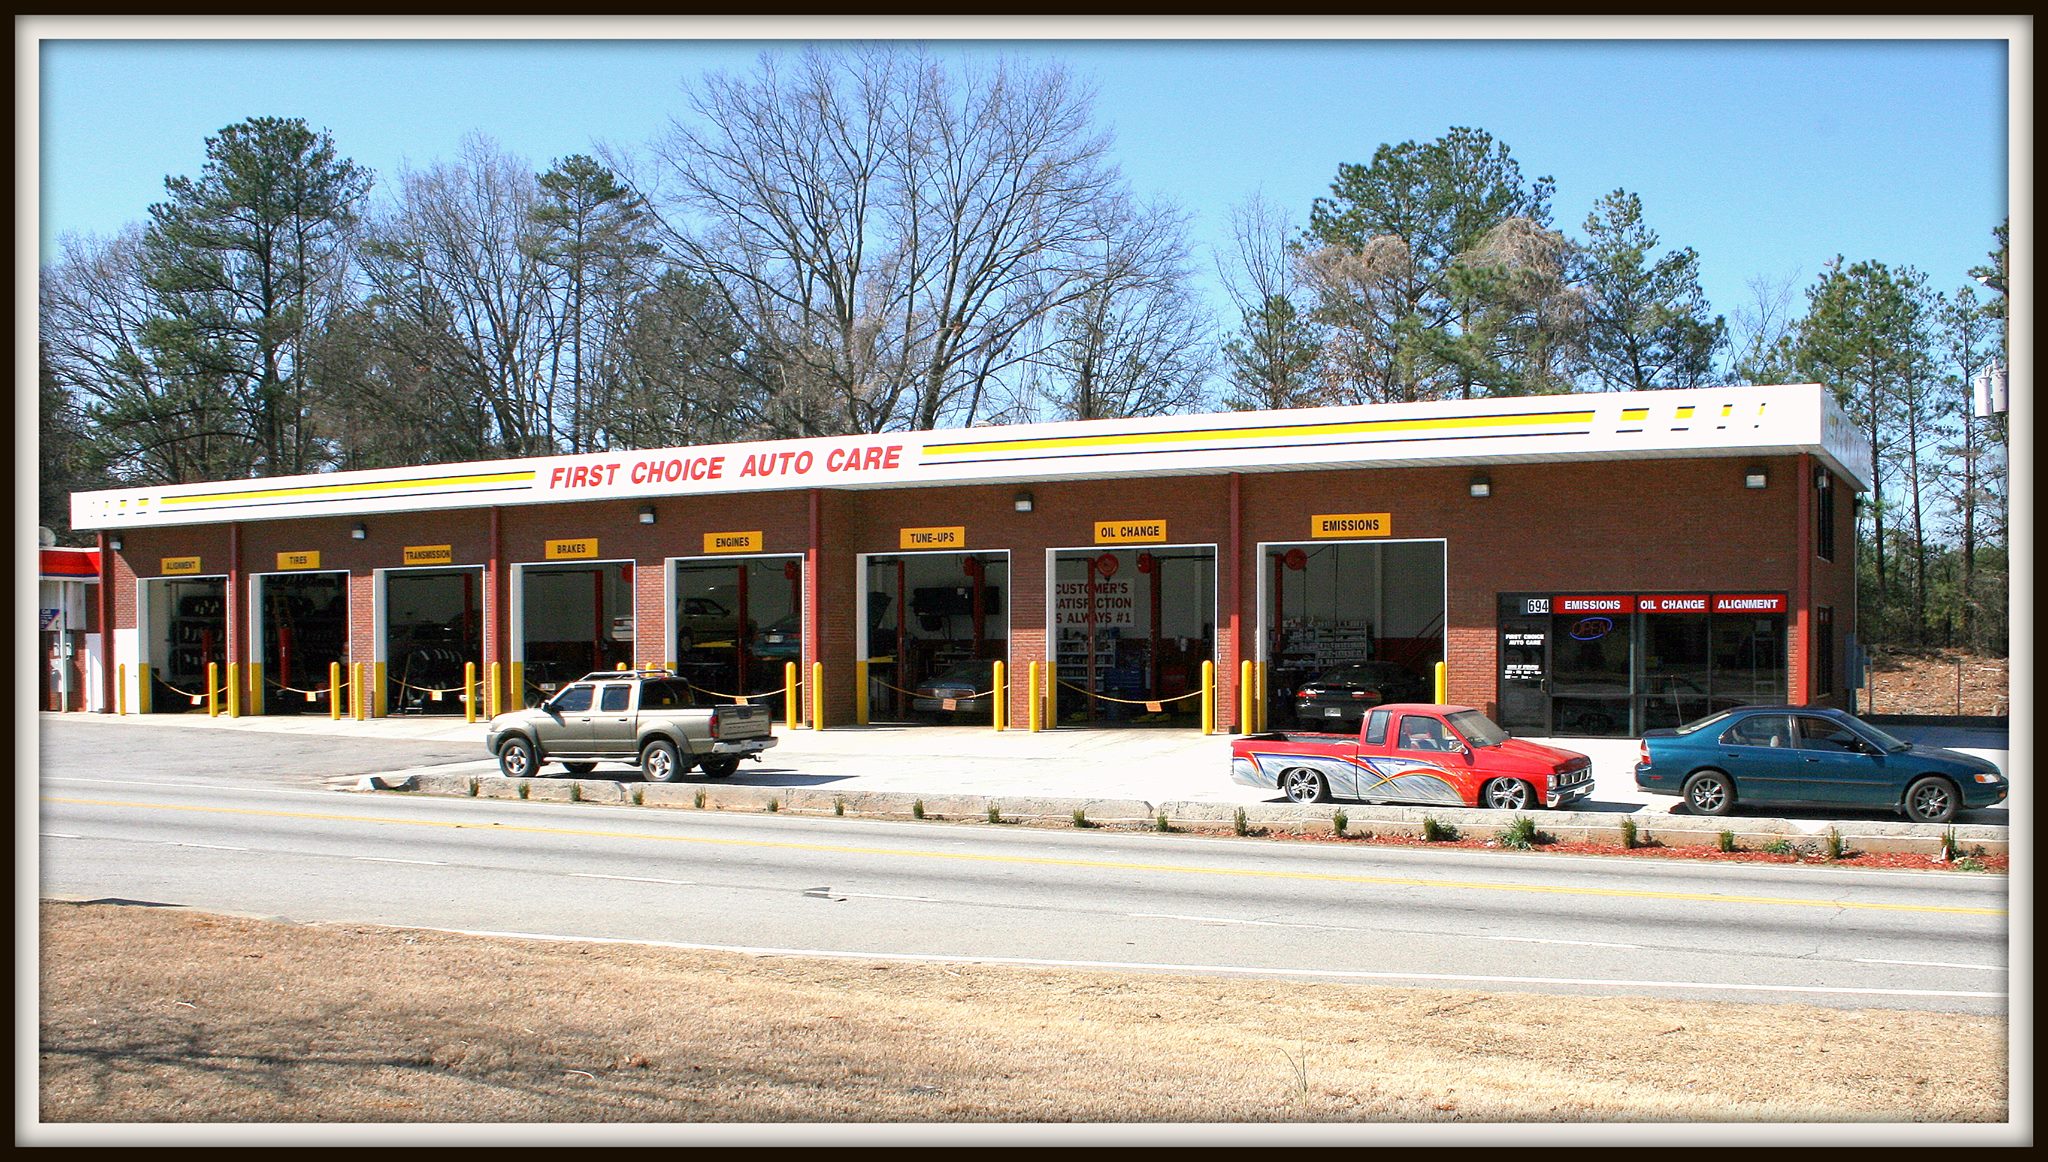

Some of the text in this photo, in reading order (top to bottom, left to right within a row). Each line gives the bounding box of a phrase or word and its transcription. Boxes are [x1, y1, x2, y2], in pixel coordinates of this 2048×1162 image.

[549, 445, 903, 489] FIRST CHOICE AUTO CARE
[1322, 519, 1380, 531] EMISSIONS
[1101, 525, 1160, 538] OIL CHANGE
[716, 536, 750, 548] ENGINES
[910, 532, 955, 544] TUNE-UPS
[557, 543, 586, 554] BRAKES
[405, 549, 451, 560] TRANSMISSION
[166, 561, 196, 570] ALIGNMENT
[289, 556, 308, 565] TIRES
[1056, 597, 1132, 609] ATISFCTION
[1528, 600, 1548, 612] 694
[1564, 600, 1621, 610] EMISSIONS
[1640, 600, 1705, 610] OIL CHANGE
[1717, 599, 1779, 609] ALIGNMENT
[1116, 612, 1131, 623] #1
